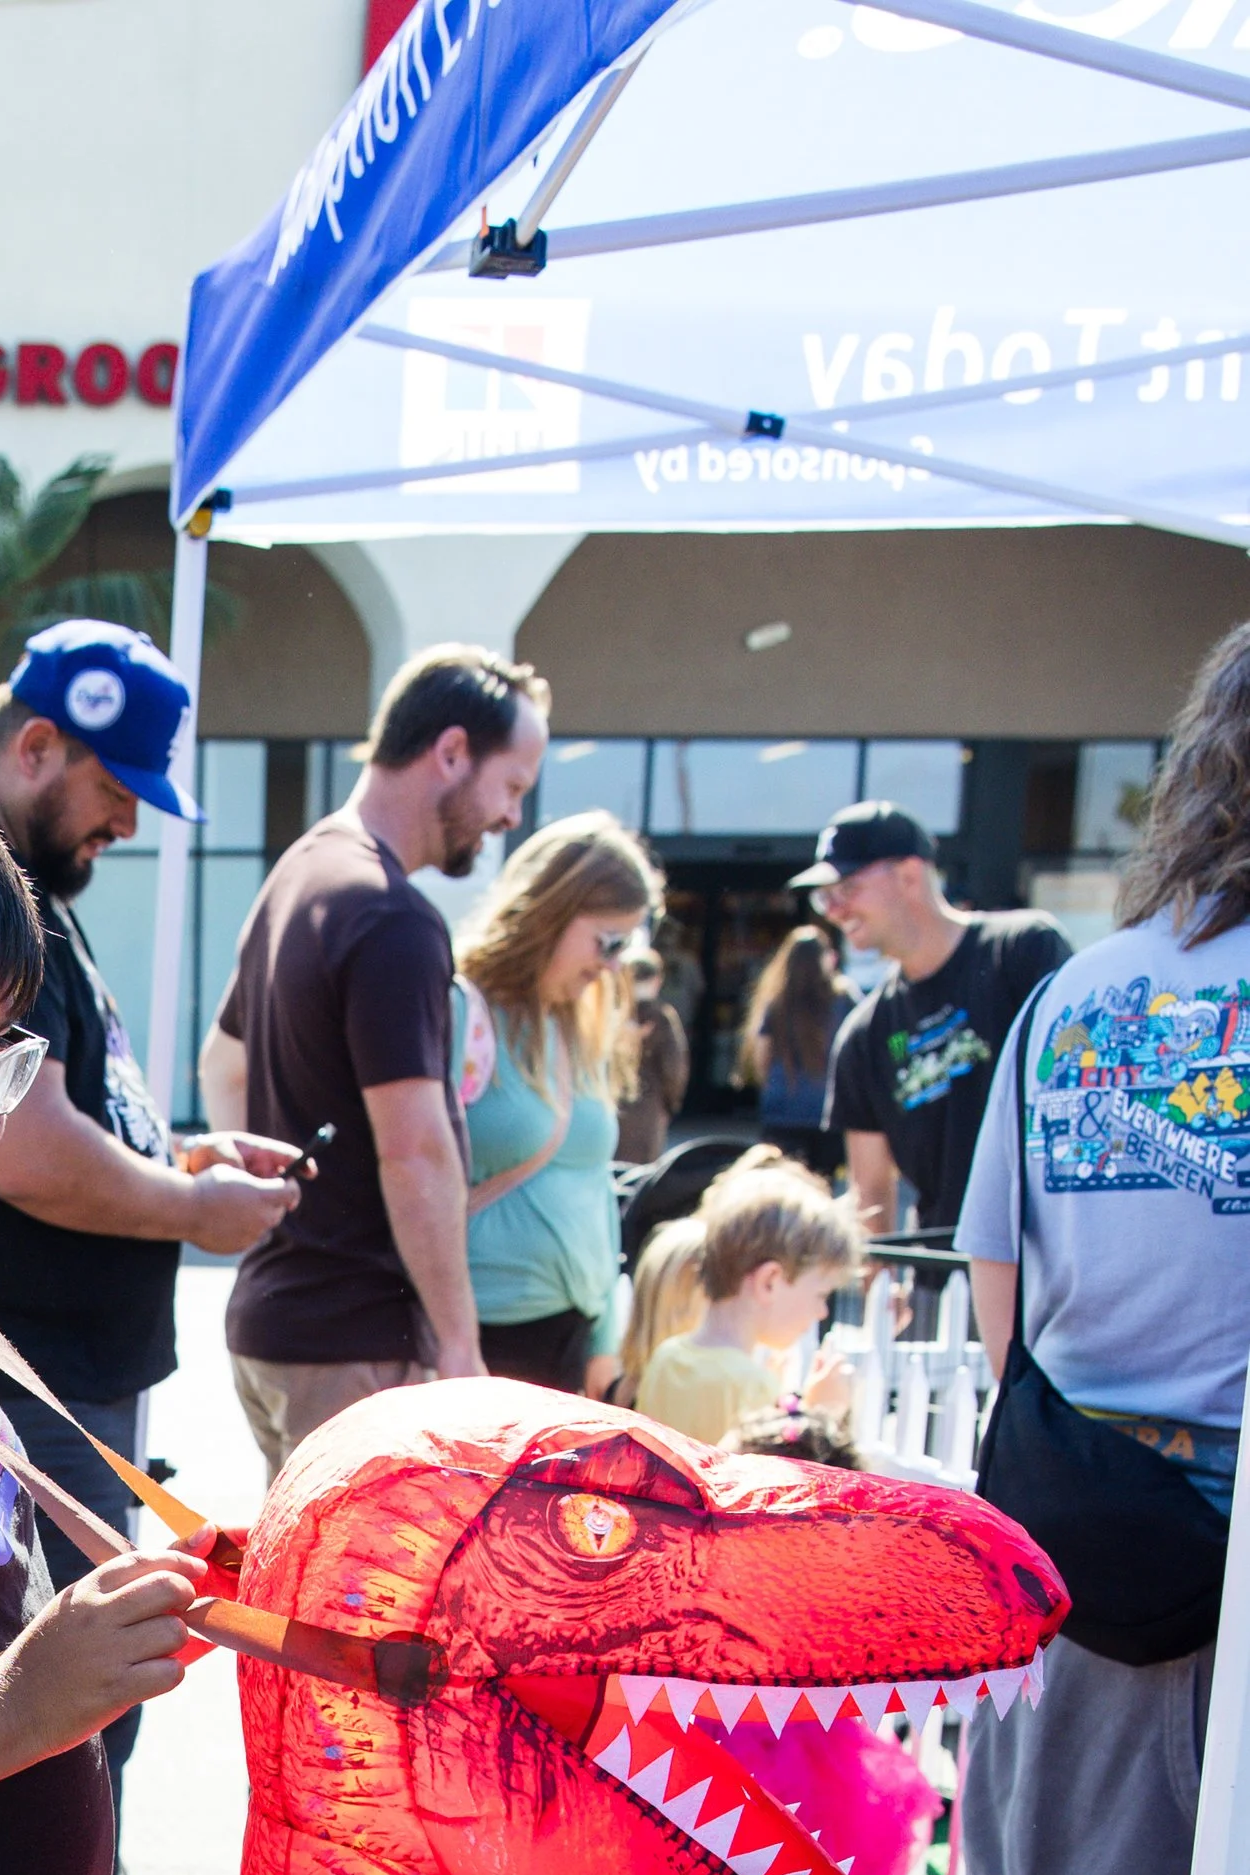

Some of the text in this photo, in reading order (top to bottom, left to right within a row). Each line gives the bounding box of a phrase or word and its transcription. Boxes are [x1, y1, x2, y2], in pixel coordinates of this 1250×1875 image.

[1081, 1066, 1144, 1088] CITY
[1110, 1088, 1238, 1184] EVERYWHERE
[1126, 1132, 1215, 1199] BETWEEN
